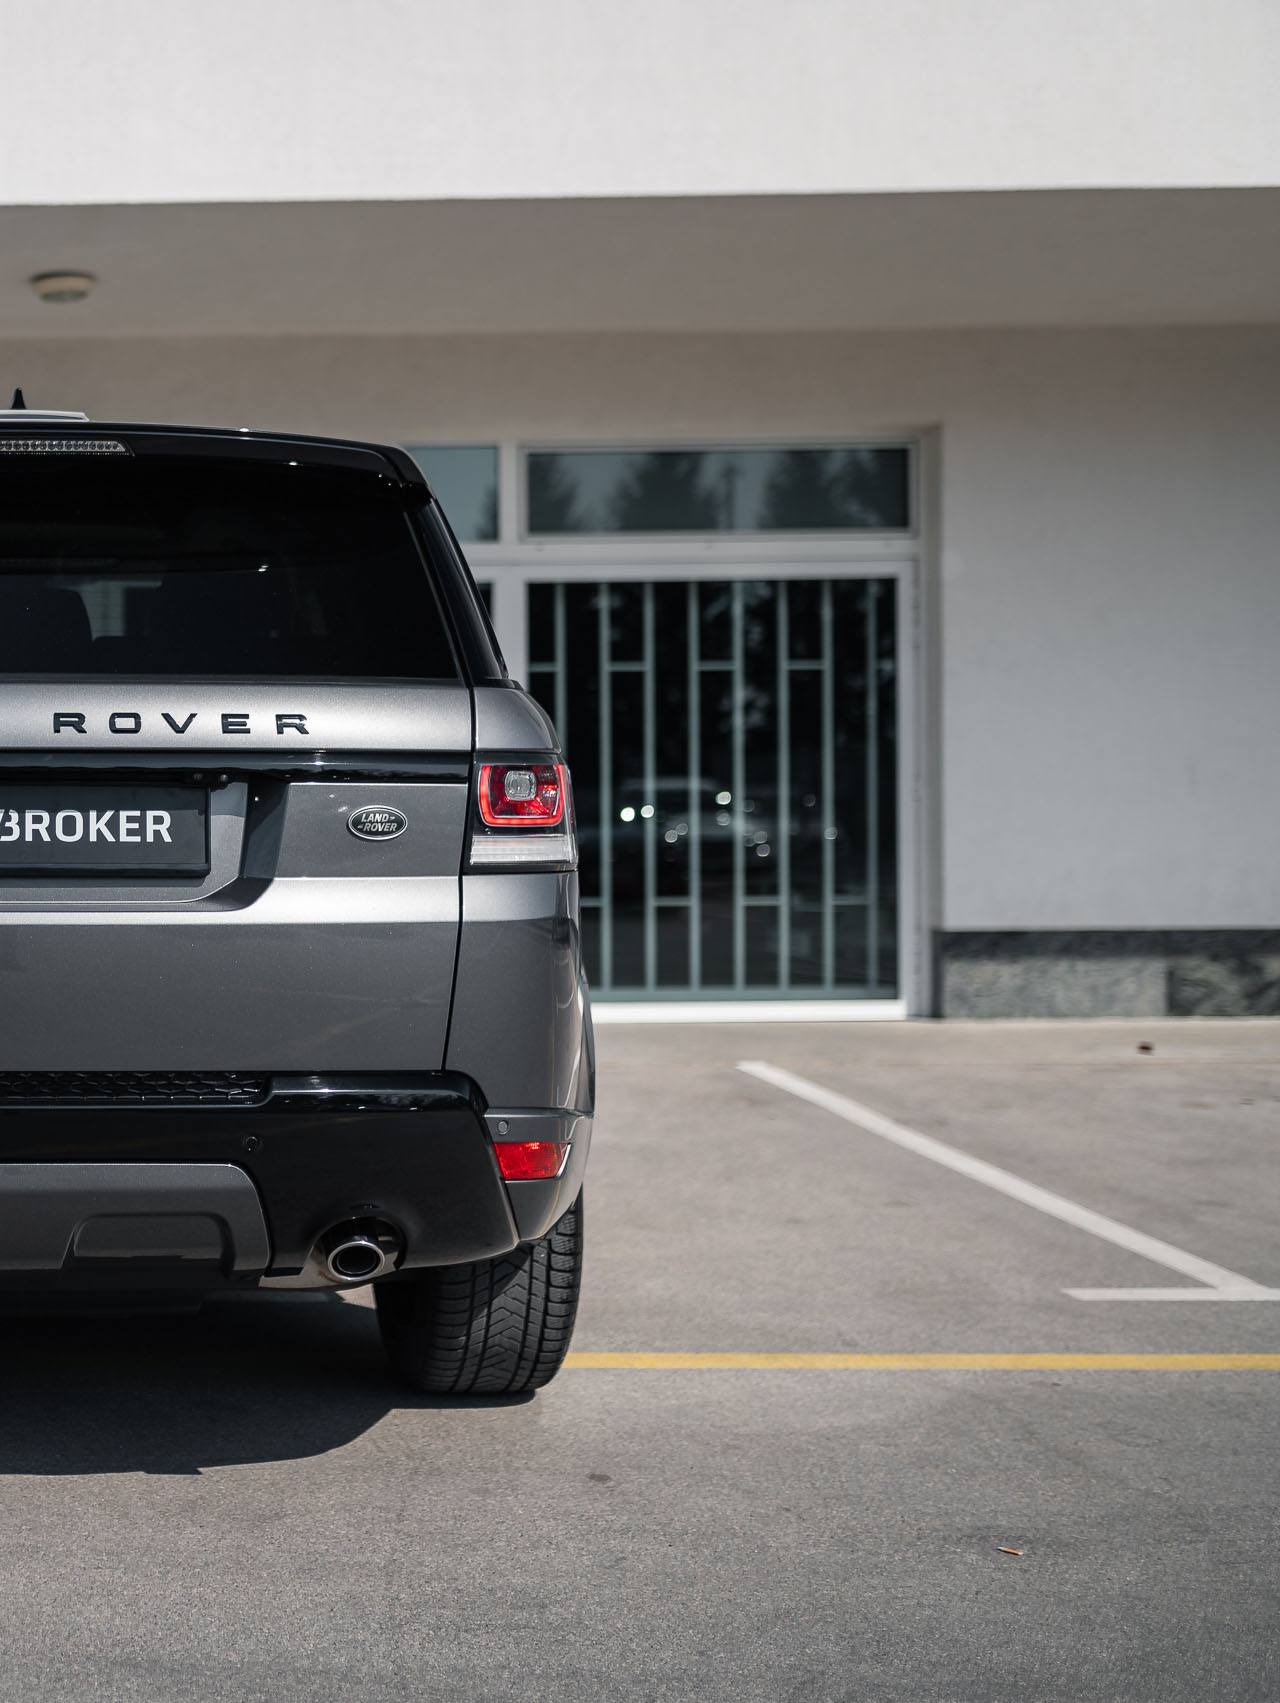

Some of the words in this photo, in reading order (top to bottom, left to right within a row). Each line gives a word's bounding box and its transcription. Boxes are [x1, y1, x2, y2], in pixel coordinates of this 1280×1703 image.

[52, 712, 311, 735] ROVER
[360, 813, 390, 823] LAND
[362, 822, 398, 832] ROVER
